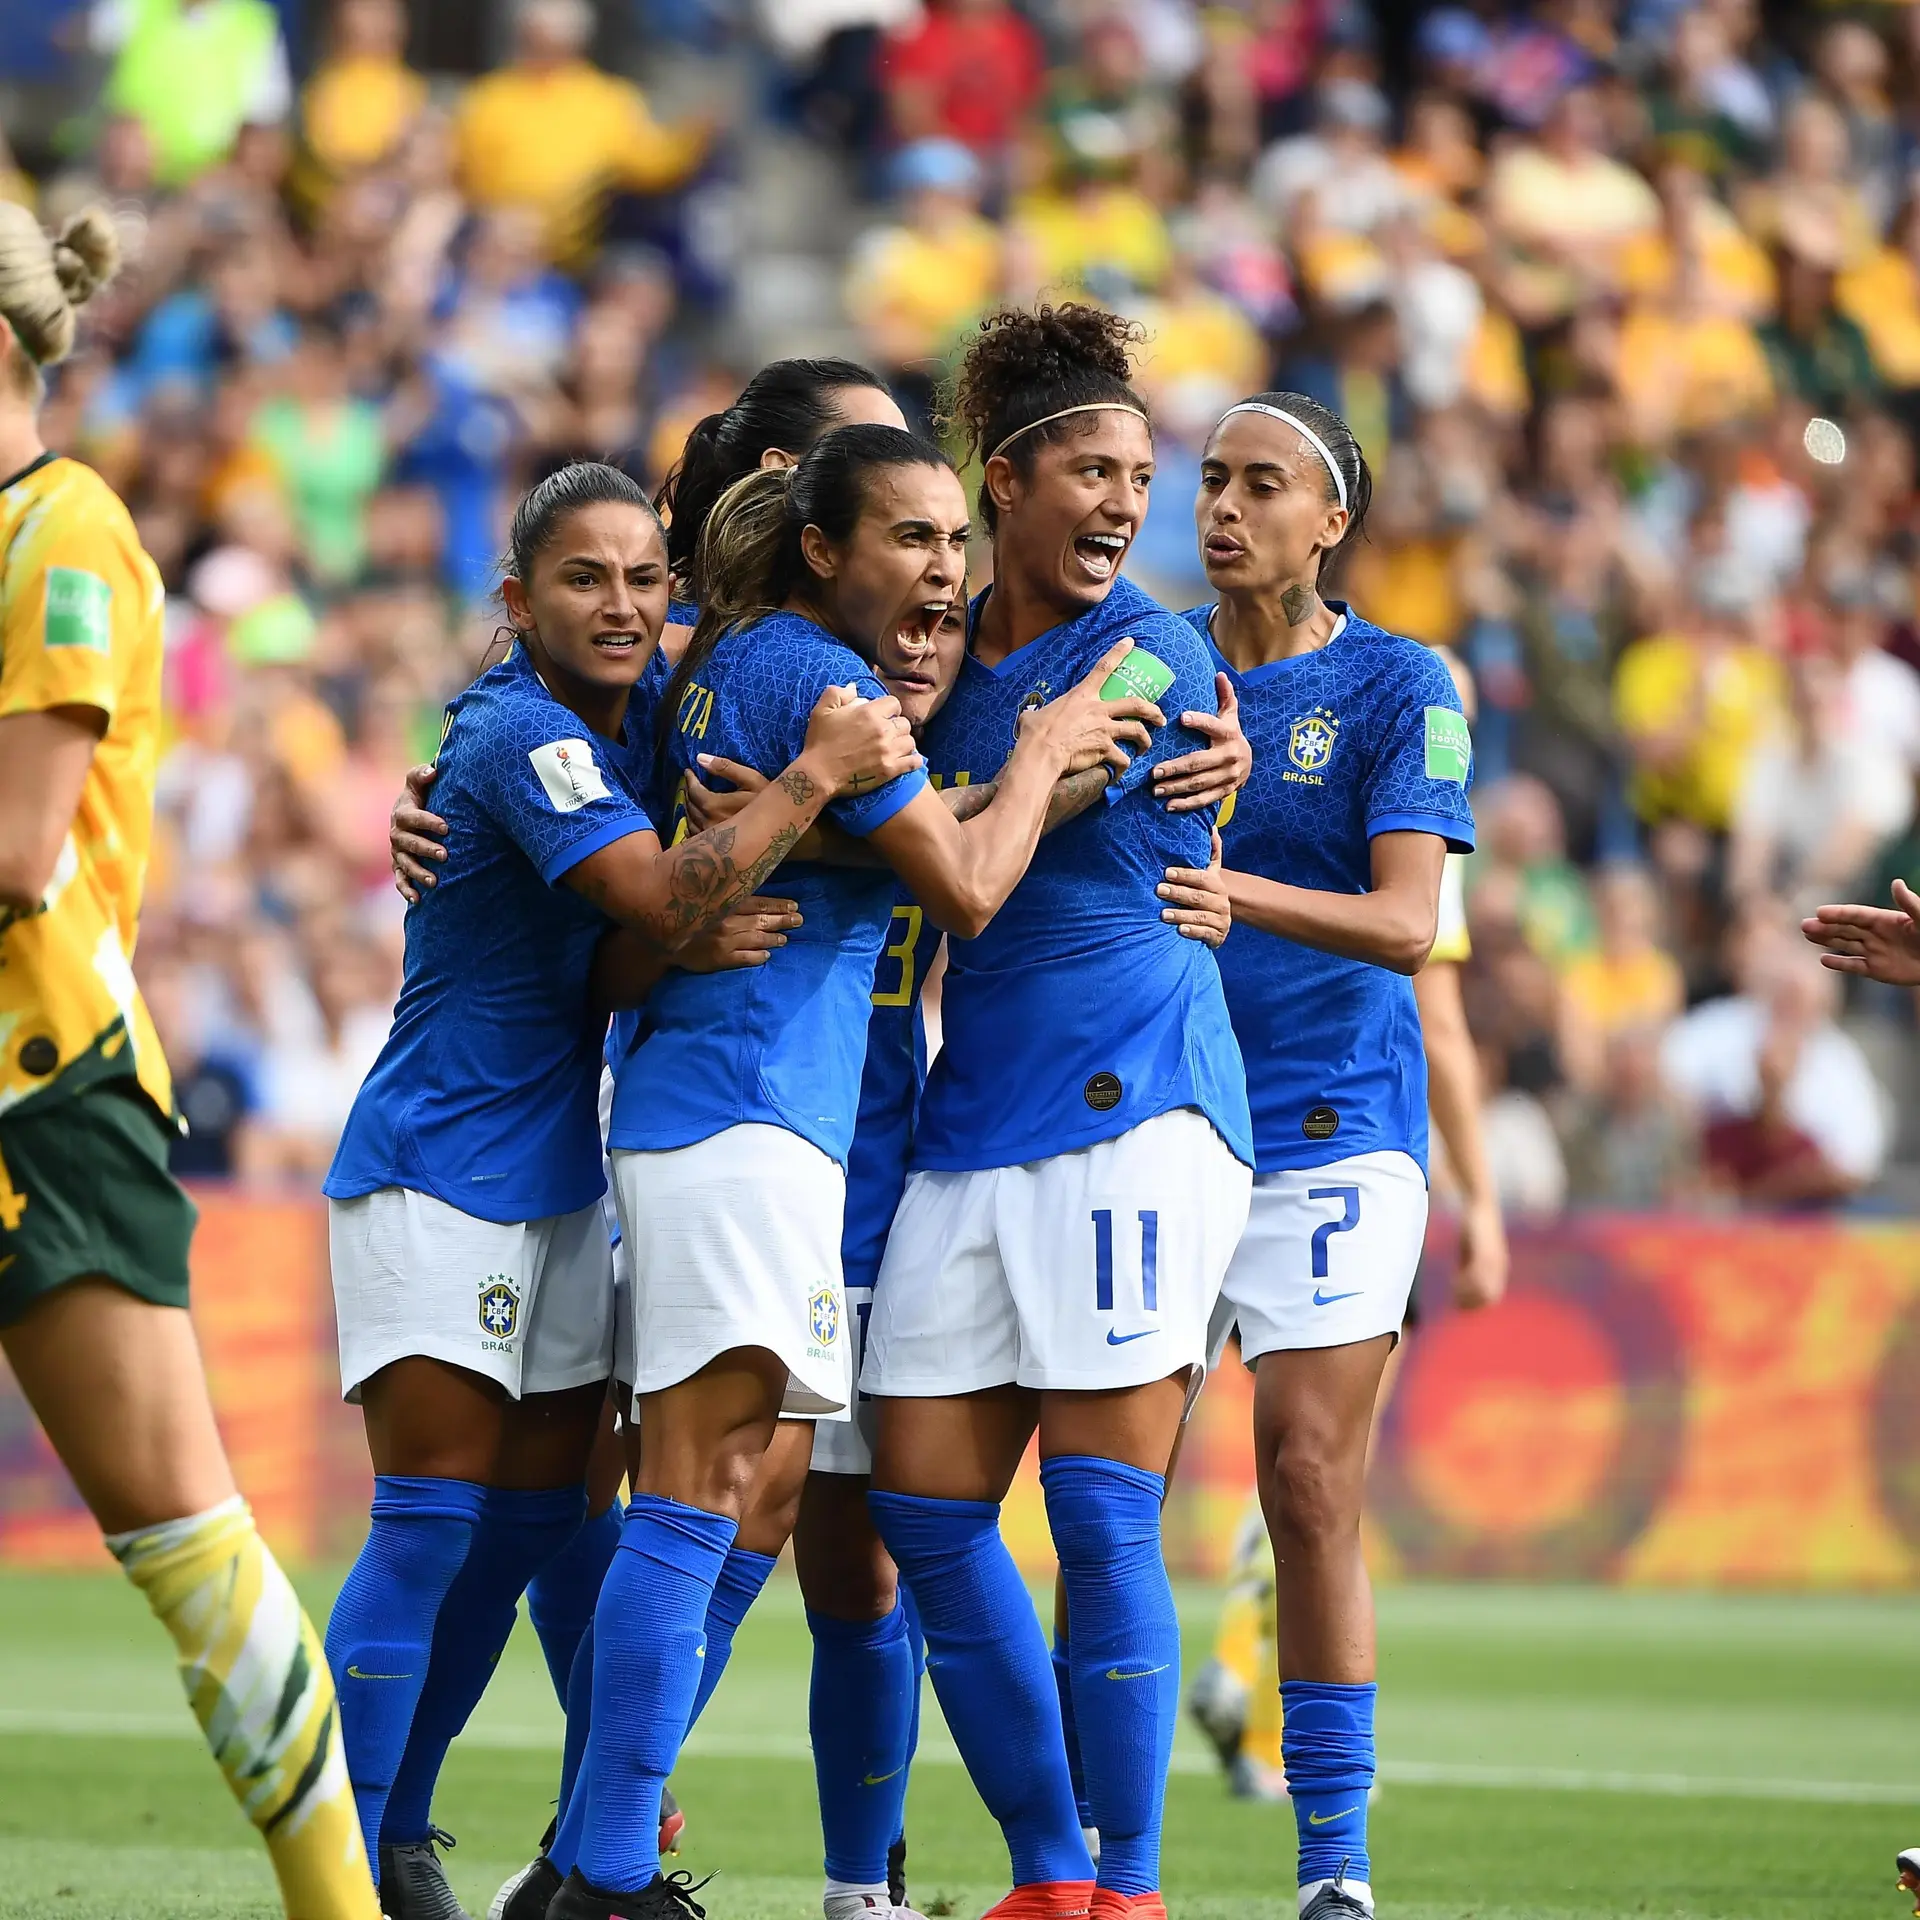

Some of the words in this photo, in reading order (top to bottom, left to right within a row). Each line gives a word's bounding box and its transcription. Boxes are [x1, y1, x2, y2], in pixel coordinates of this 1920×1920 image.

[1304, 739, 1320, 747] CBF
[1281, 771, 1326, 786] BRASIL
[1308, 1187, 1361, 1278] 7
[1091, 1209, 1158, 1312] 11
[491, 1307, 507, 1315] CBF
[481, 1341, 514, 1354] BRASIL
[806, 1347, 836, 1362] BRASIL
